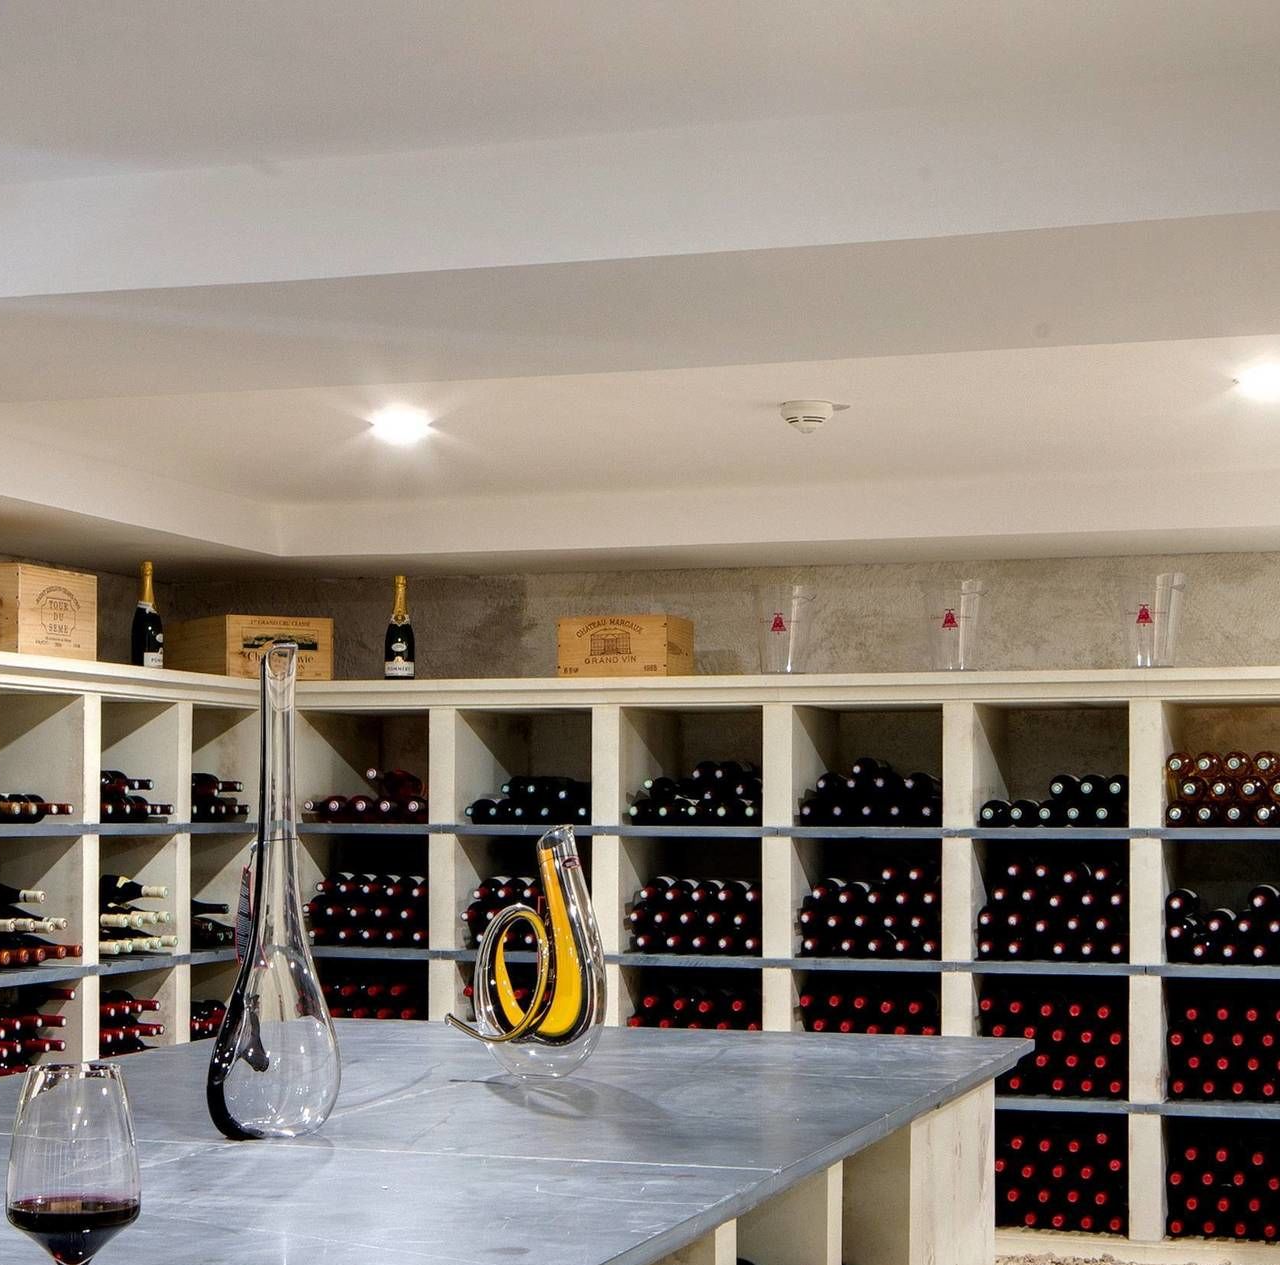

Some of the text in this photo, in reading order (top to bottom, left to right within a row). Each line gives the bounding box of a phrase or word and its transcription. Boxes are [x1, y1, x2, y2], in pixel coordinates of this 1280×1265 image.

[53, 612, 64, 621] DU
[609, 618, 642, 634] MARGAUX
[622, 655, 637, 663] VIN
